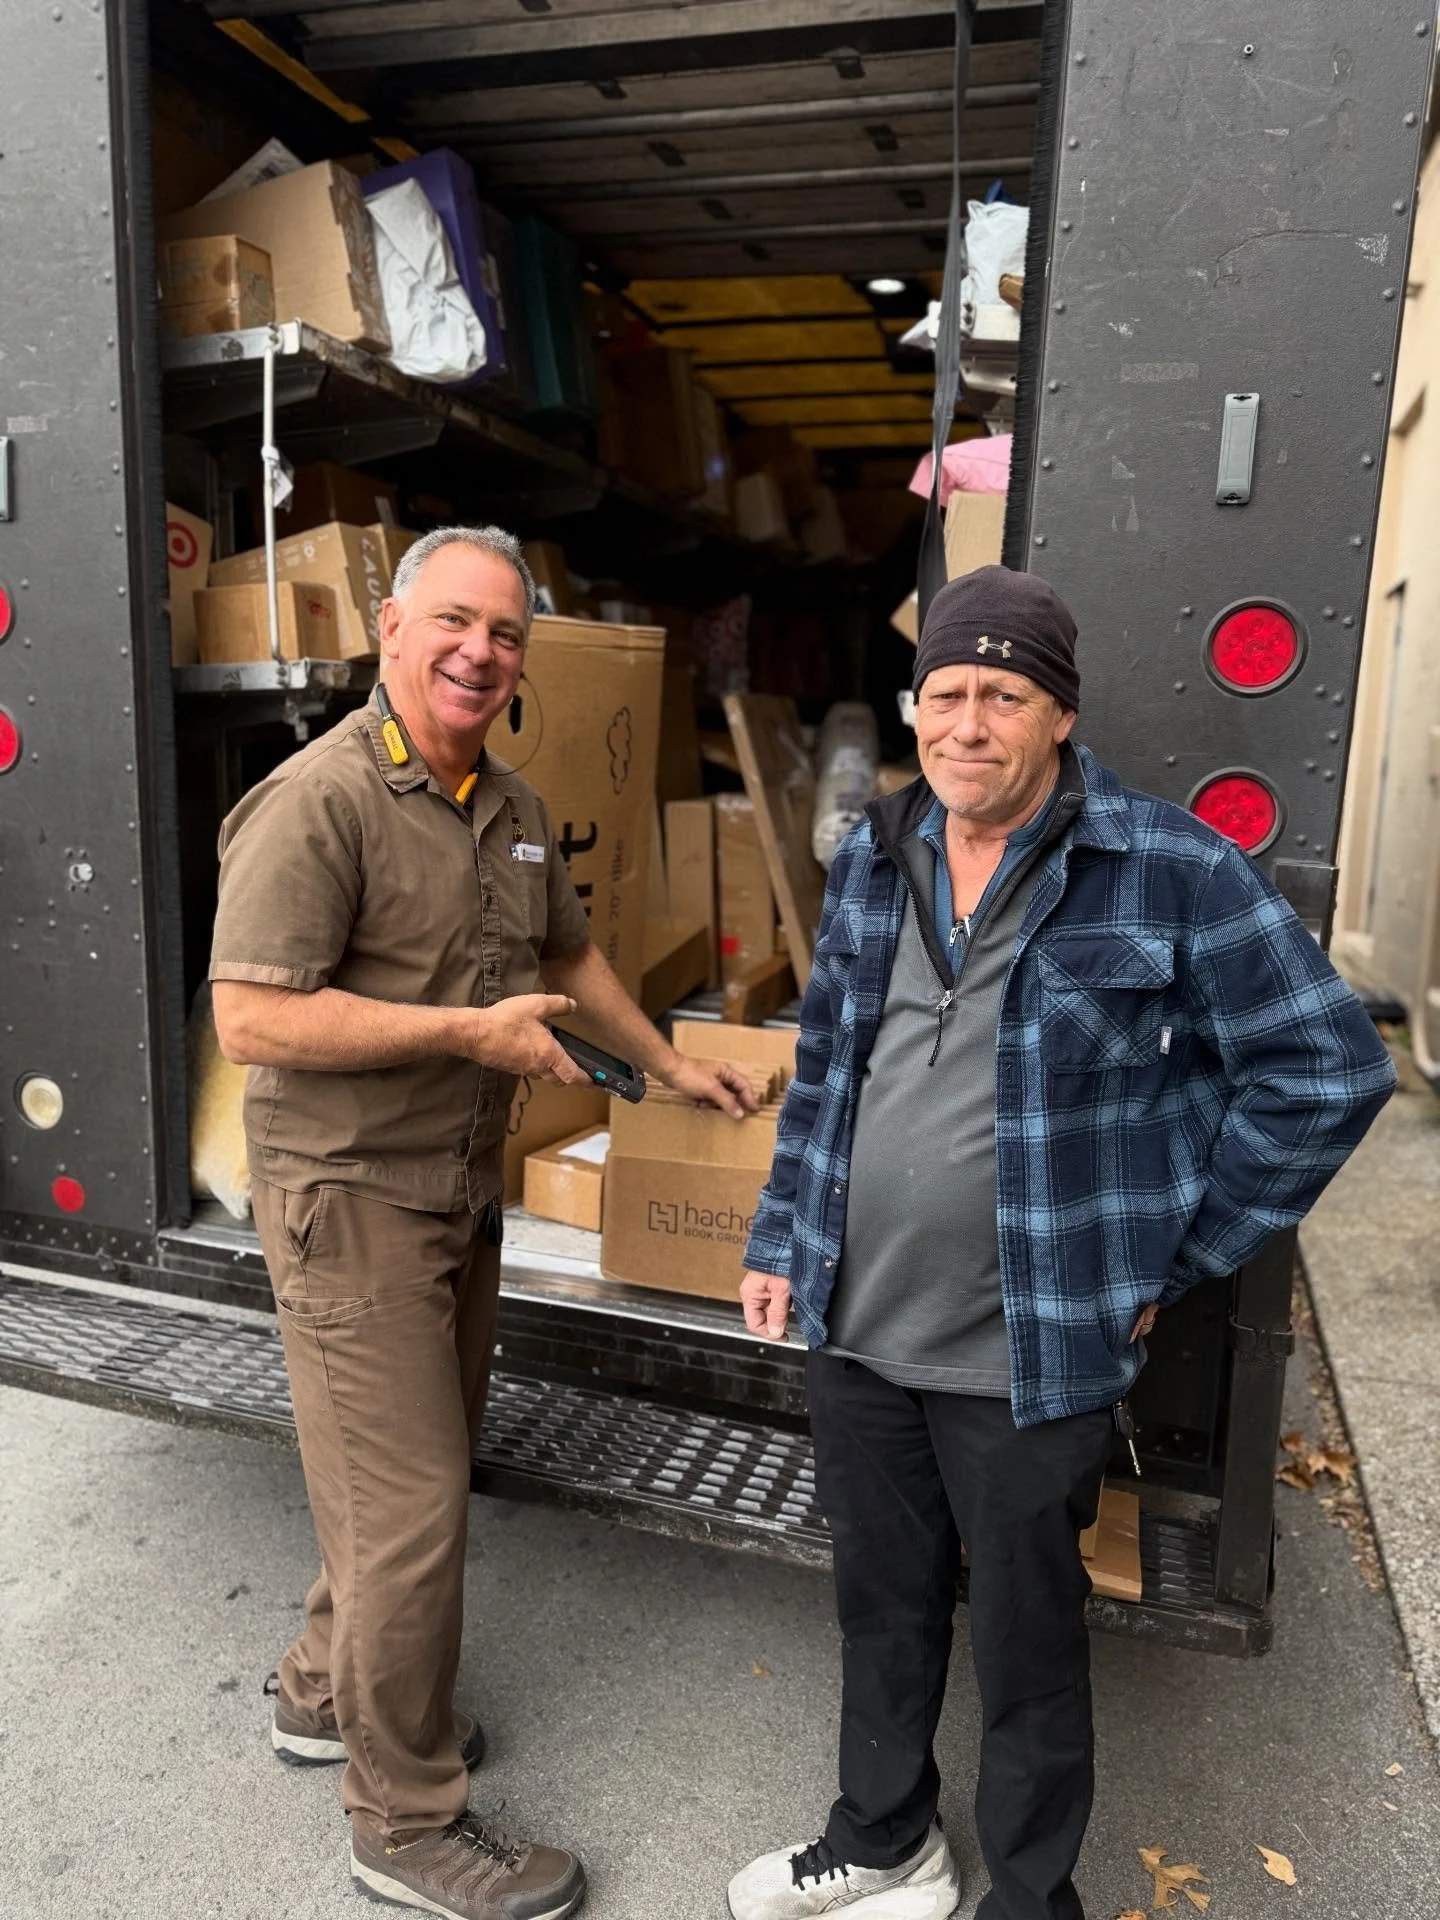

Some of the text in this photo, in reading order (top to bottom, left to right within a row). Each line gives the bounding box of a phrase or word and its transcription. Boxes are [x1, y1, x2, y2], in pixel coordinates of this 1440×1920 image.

[684, 1200, 755, 1233] hache
[684, 1227, 750, 1246] BOOK GROU
